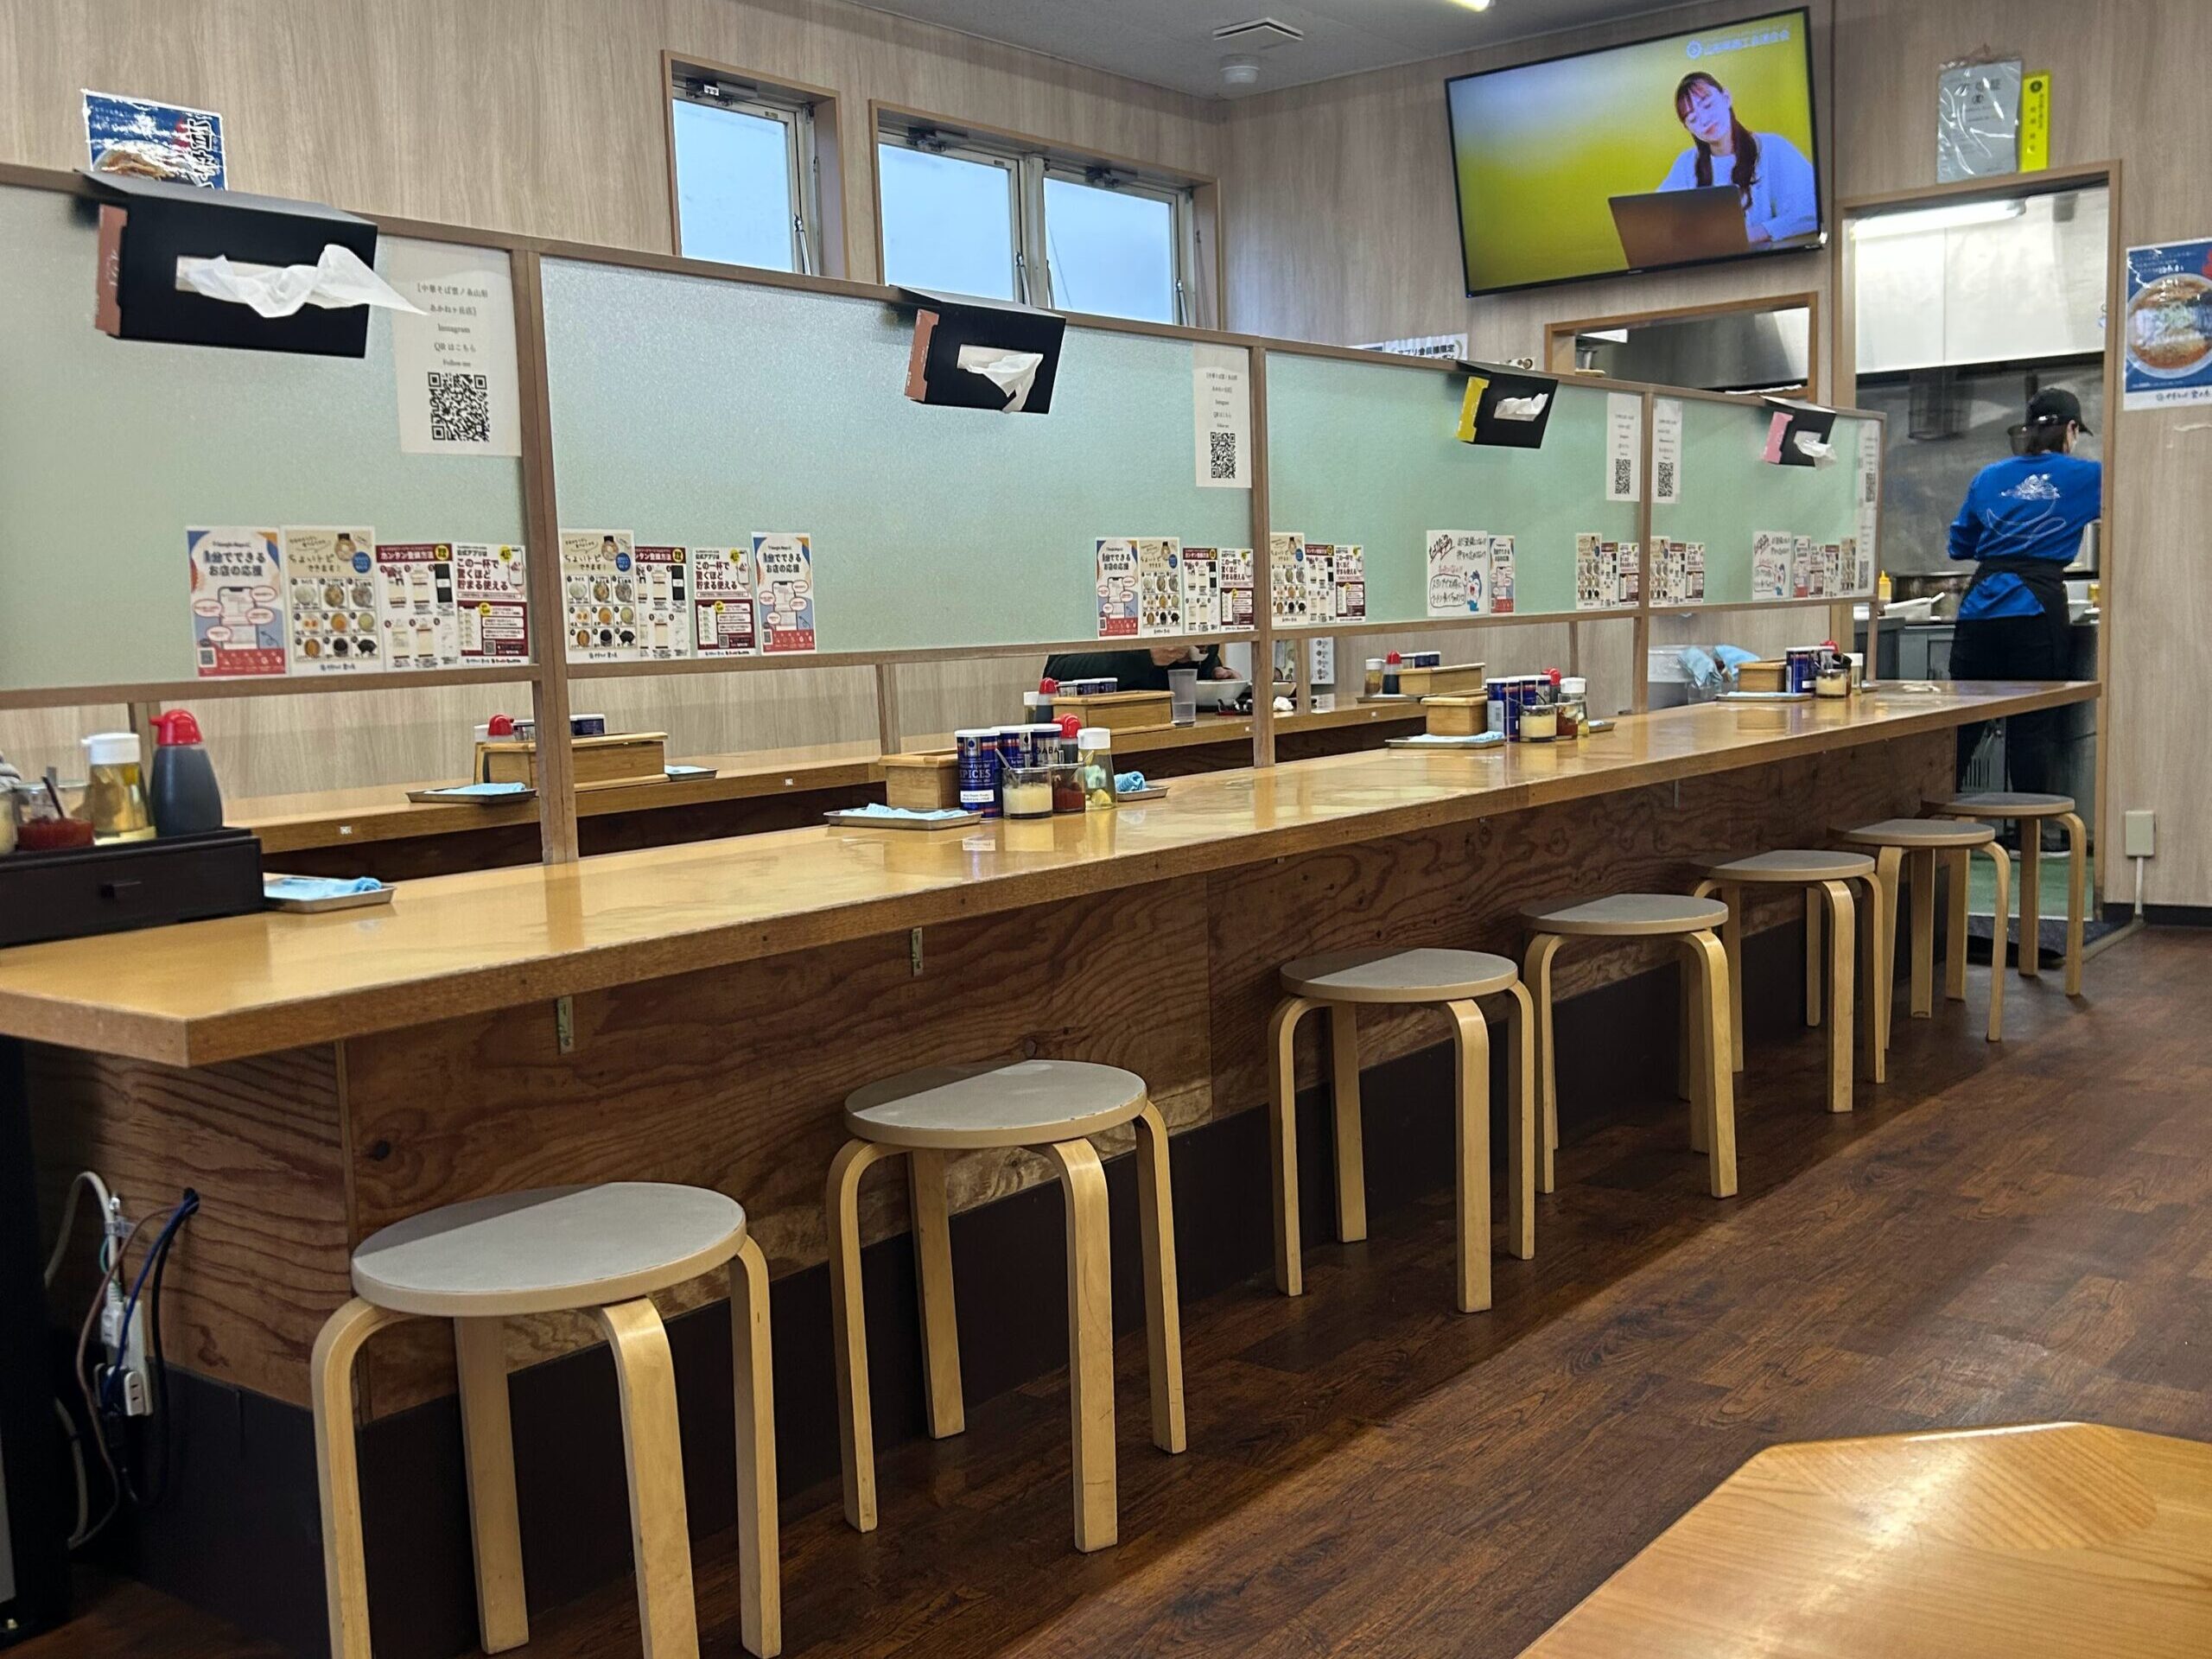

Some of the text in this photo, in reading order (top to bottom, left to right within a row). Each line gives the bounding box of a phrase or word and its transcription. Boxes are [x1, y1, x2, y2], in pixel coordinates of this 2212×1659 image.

[457, 558, 499, 569] この一杯で
[696, 562, 729, 570] この一杯で
